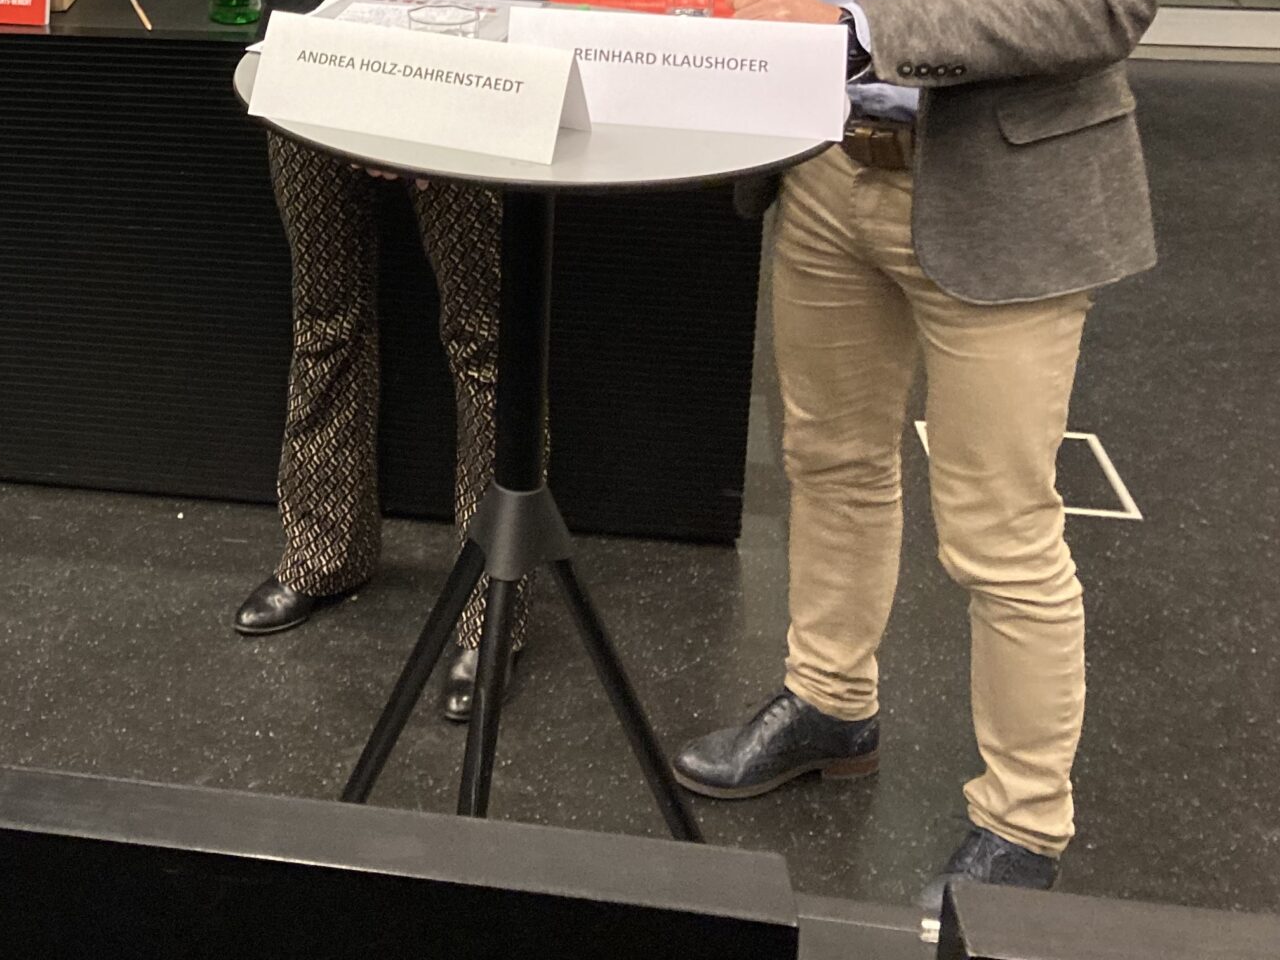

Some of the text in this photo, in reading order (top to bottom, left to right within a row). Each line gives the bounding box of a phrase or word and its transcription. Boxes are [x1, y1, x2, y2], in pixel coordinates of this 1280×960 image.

[297, 49, 524, 95] ANDREA HOLZ-DAHRENSTAEDT
[574, 47, 769, 73] REINHARD KLAUSHOFER
